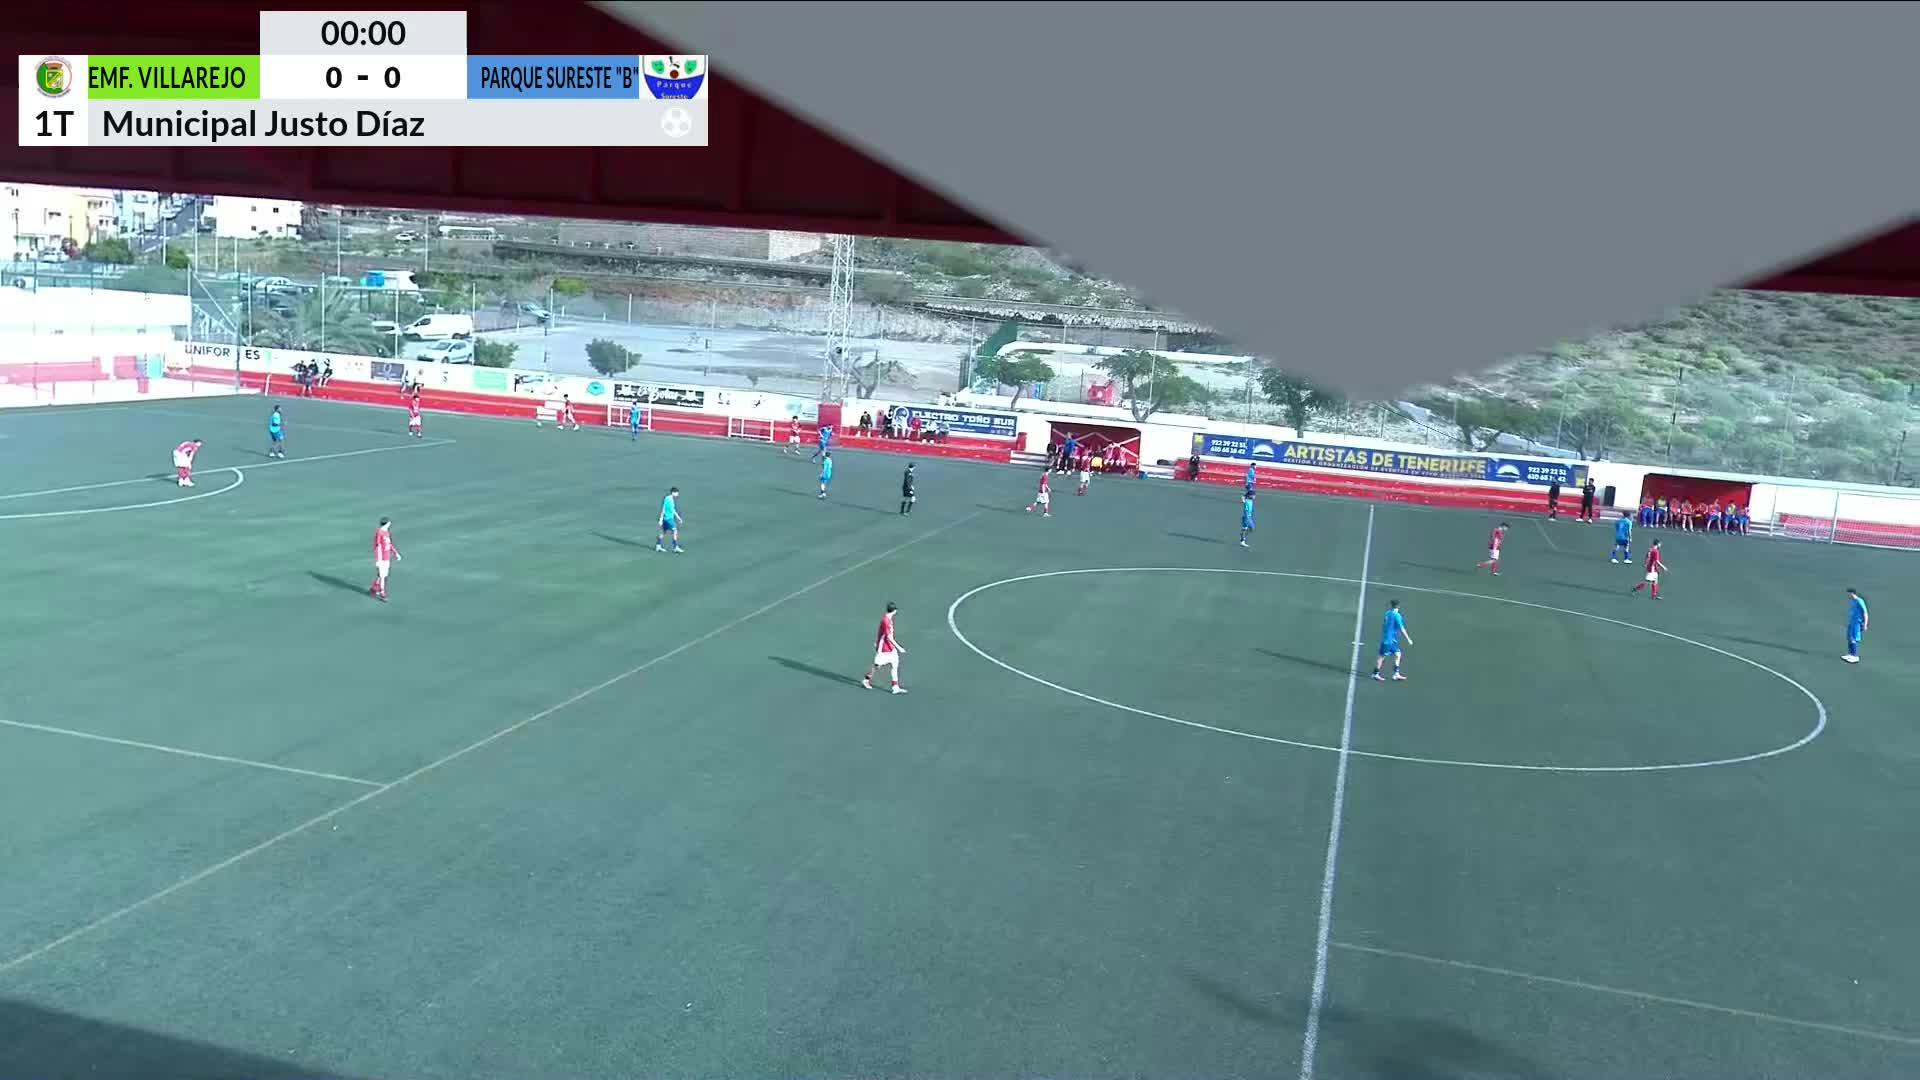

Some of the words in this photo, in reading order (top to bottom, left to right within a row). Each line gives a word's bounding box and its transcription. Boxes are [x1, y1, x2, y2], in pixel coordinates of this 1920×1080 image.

[1284, 444, 1368, 465] ARTISTAS
[1371, 452, 1394, 467] DE
[1397, 453, 1486, 474] TENERIFE
